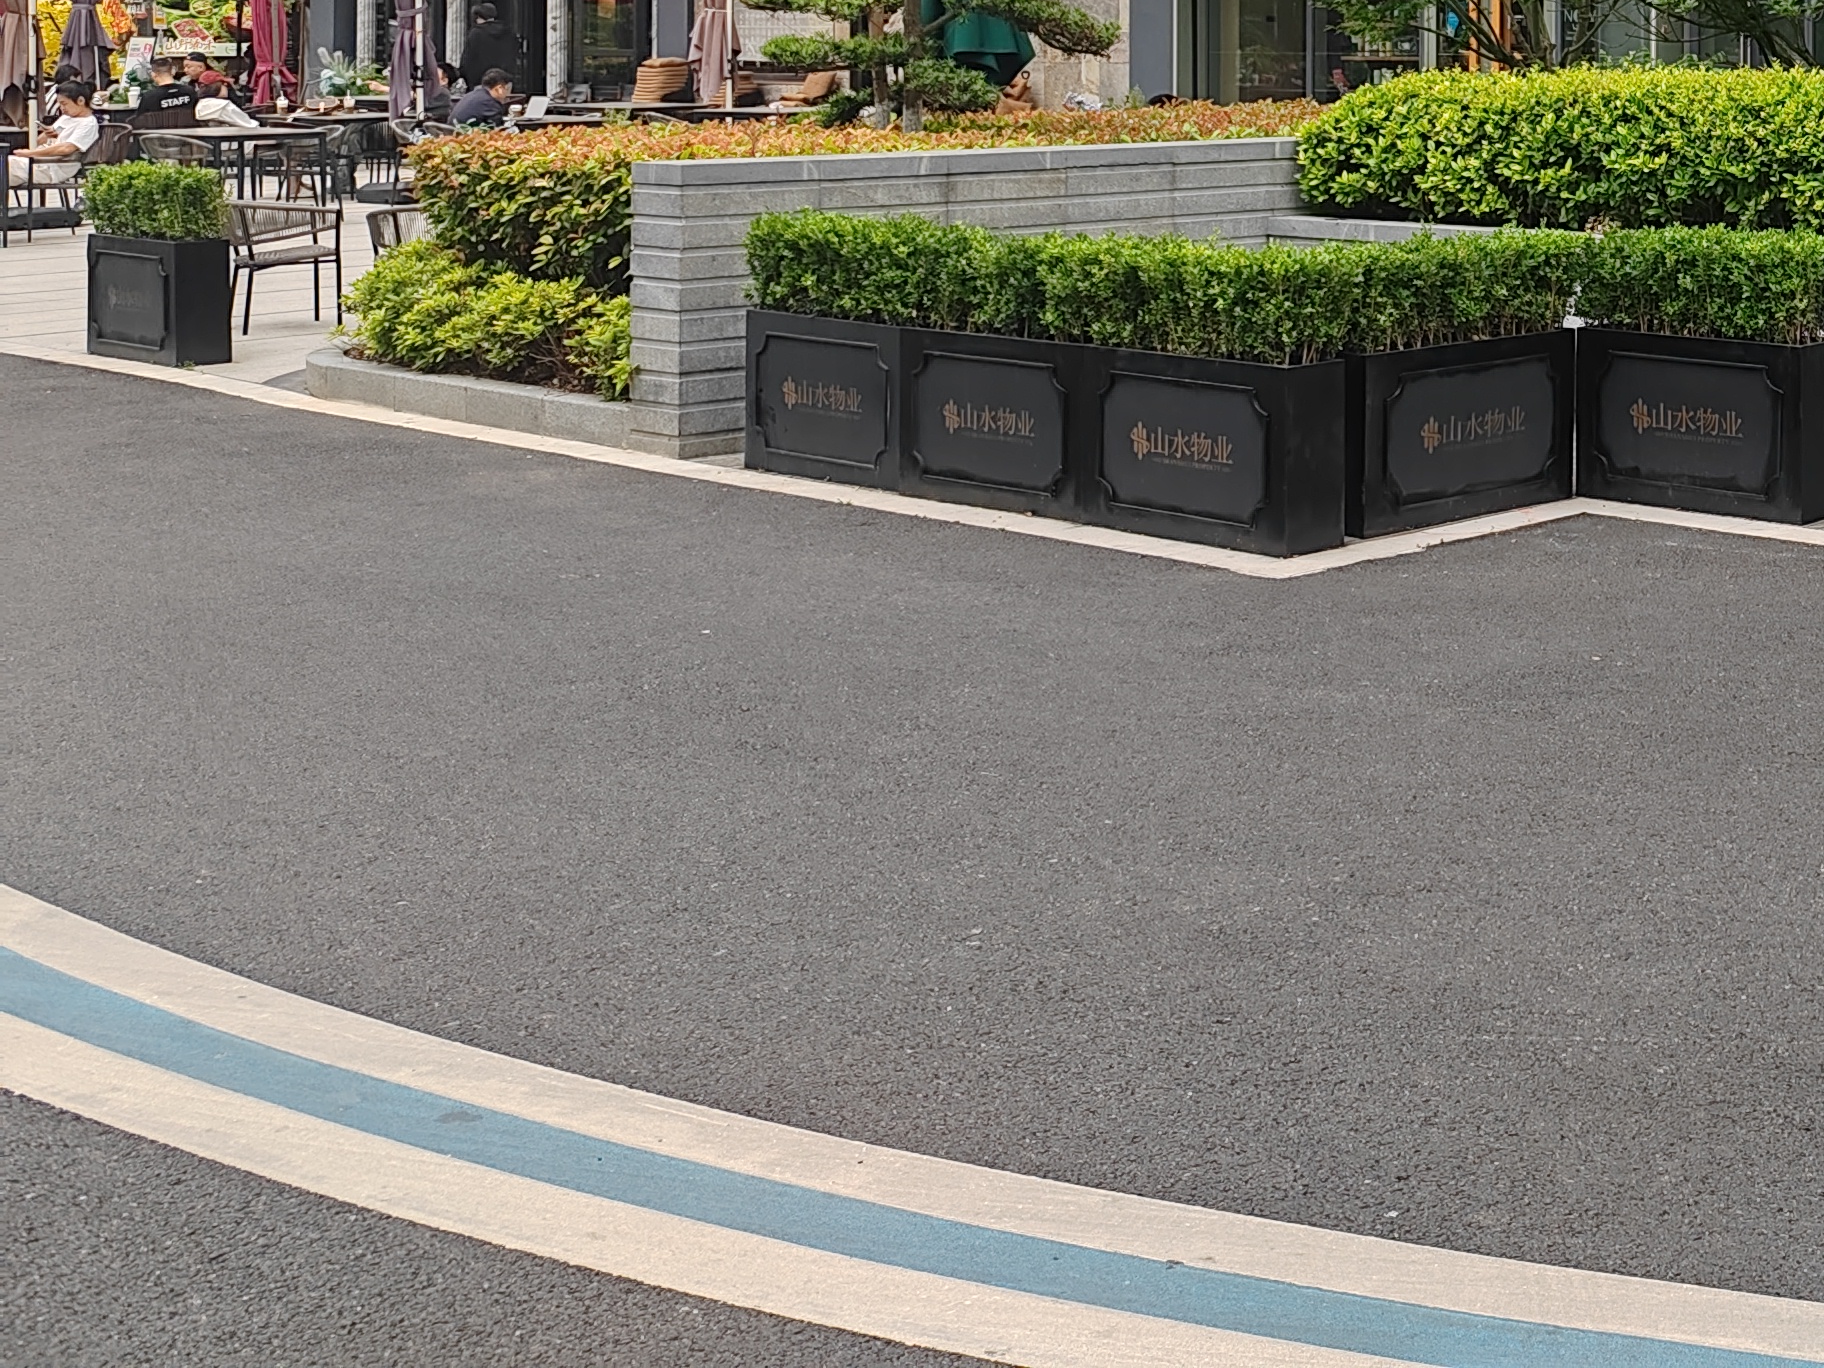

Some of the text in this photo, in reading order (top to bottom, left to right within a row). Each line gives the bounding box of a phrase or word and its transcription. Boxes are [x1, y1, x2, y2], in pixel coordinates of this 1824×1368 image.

[161, 95, 191, 109] STAFF
[797, 379, 863, 413] 山水物业
[961, 402, 1035, 437] 山水物业
[1443, 405, 1526, 444] 山水物业
[1652, 402, 1744, 438] 山水物业
[1150, 426, 1234, 464] 山水物业
